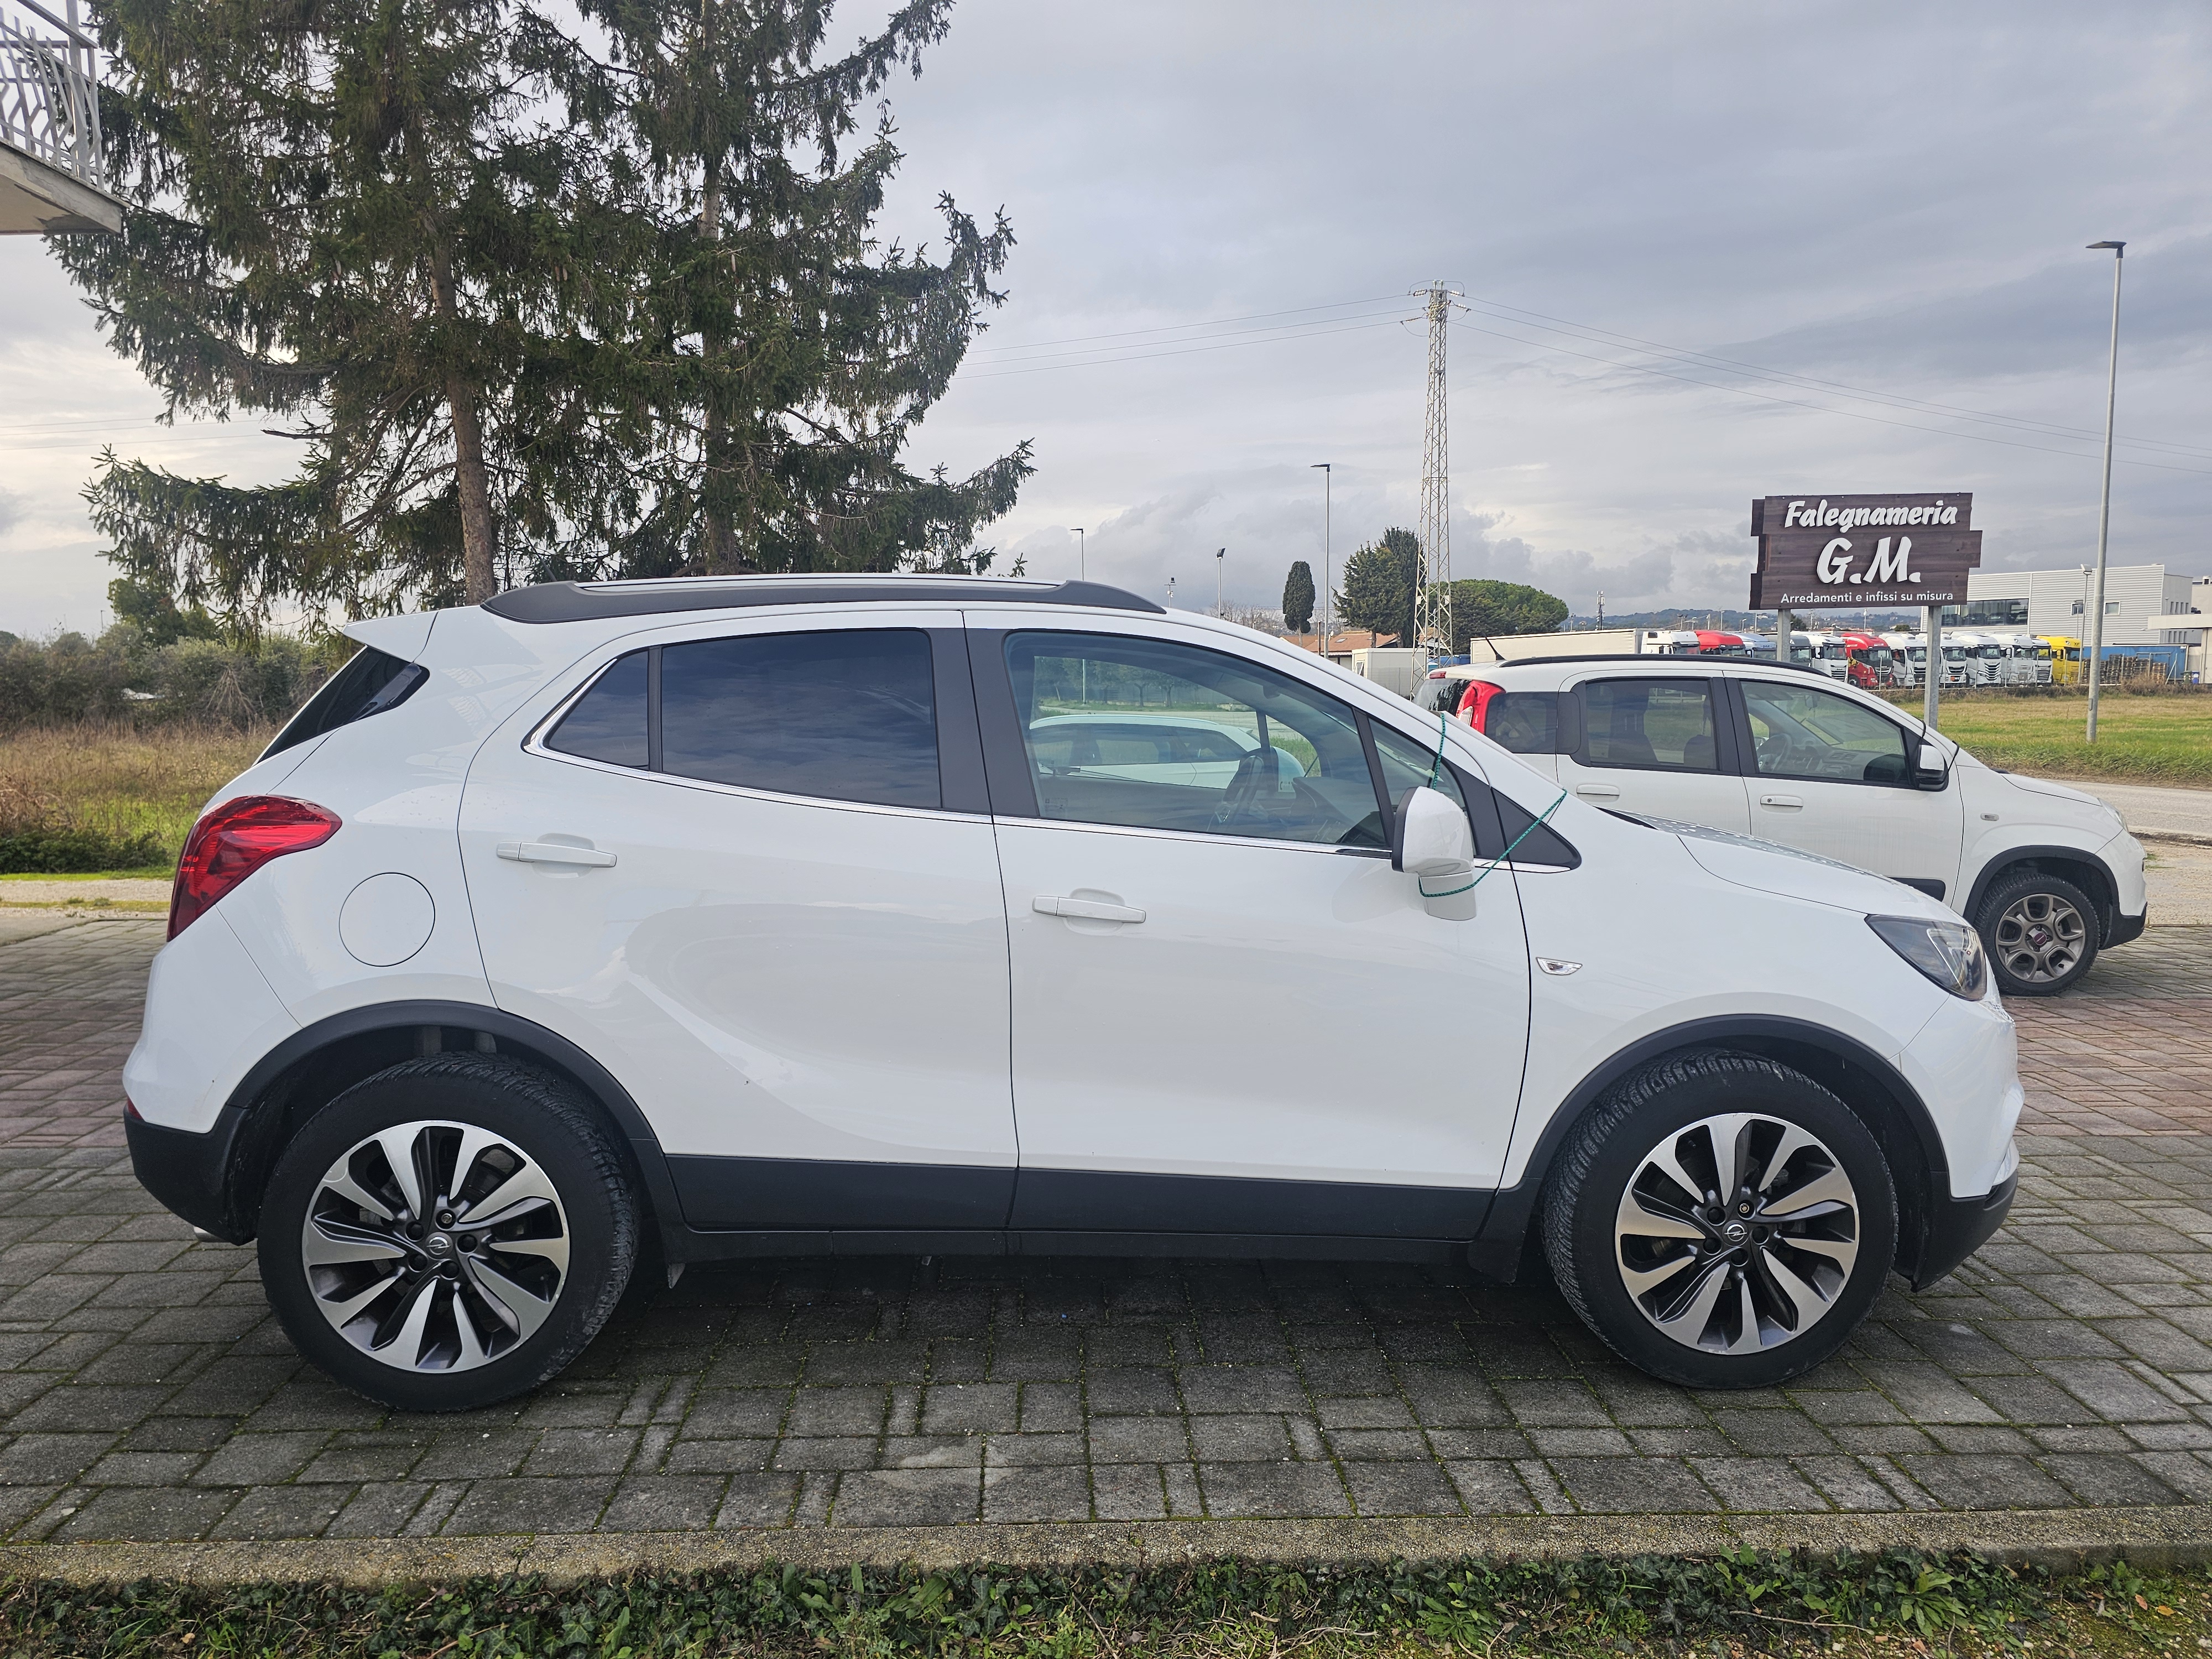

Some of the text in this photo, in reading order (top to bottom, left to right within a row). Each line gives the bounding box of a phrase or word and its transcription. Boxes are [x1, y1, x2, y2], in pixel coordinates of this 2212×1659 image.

[1785, 499, 1958, 533] Falegnameria
[1817, 536, 1921, 585] G.M.
[1781, 592, 1852, 603] Arredamenti
[1866, 591, 1897, 601] infissi
[1916, 591, 1953, 601] misura
